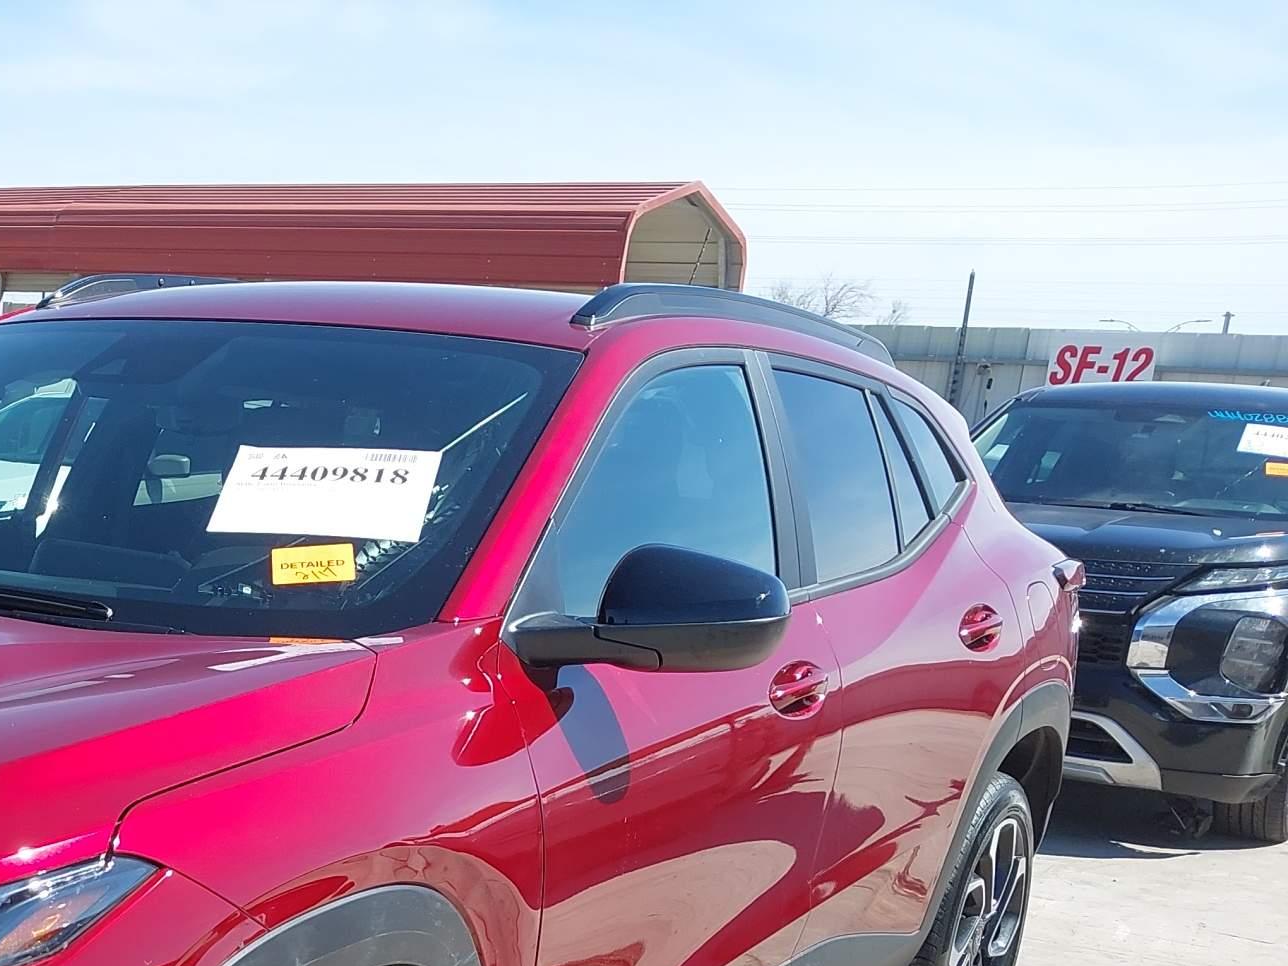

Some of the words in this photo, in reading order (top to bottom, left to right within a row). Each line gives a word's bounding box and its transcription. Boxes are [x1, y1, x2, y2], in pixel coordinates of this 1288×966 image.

[1049, 345, 1154, 385] SF-12
[250, 465, 410, 485] 44409818
[280, 559, 346, 570] DETAILED
